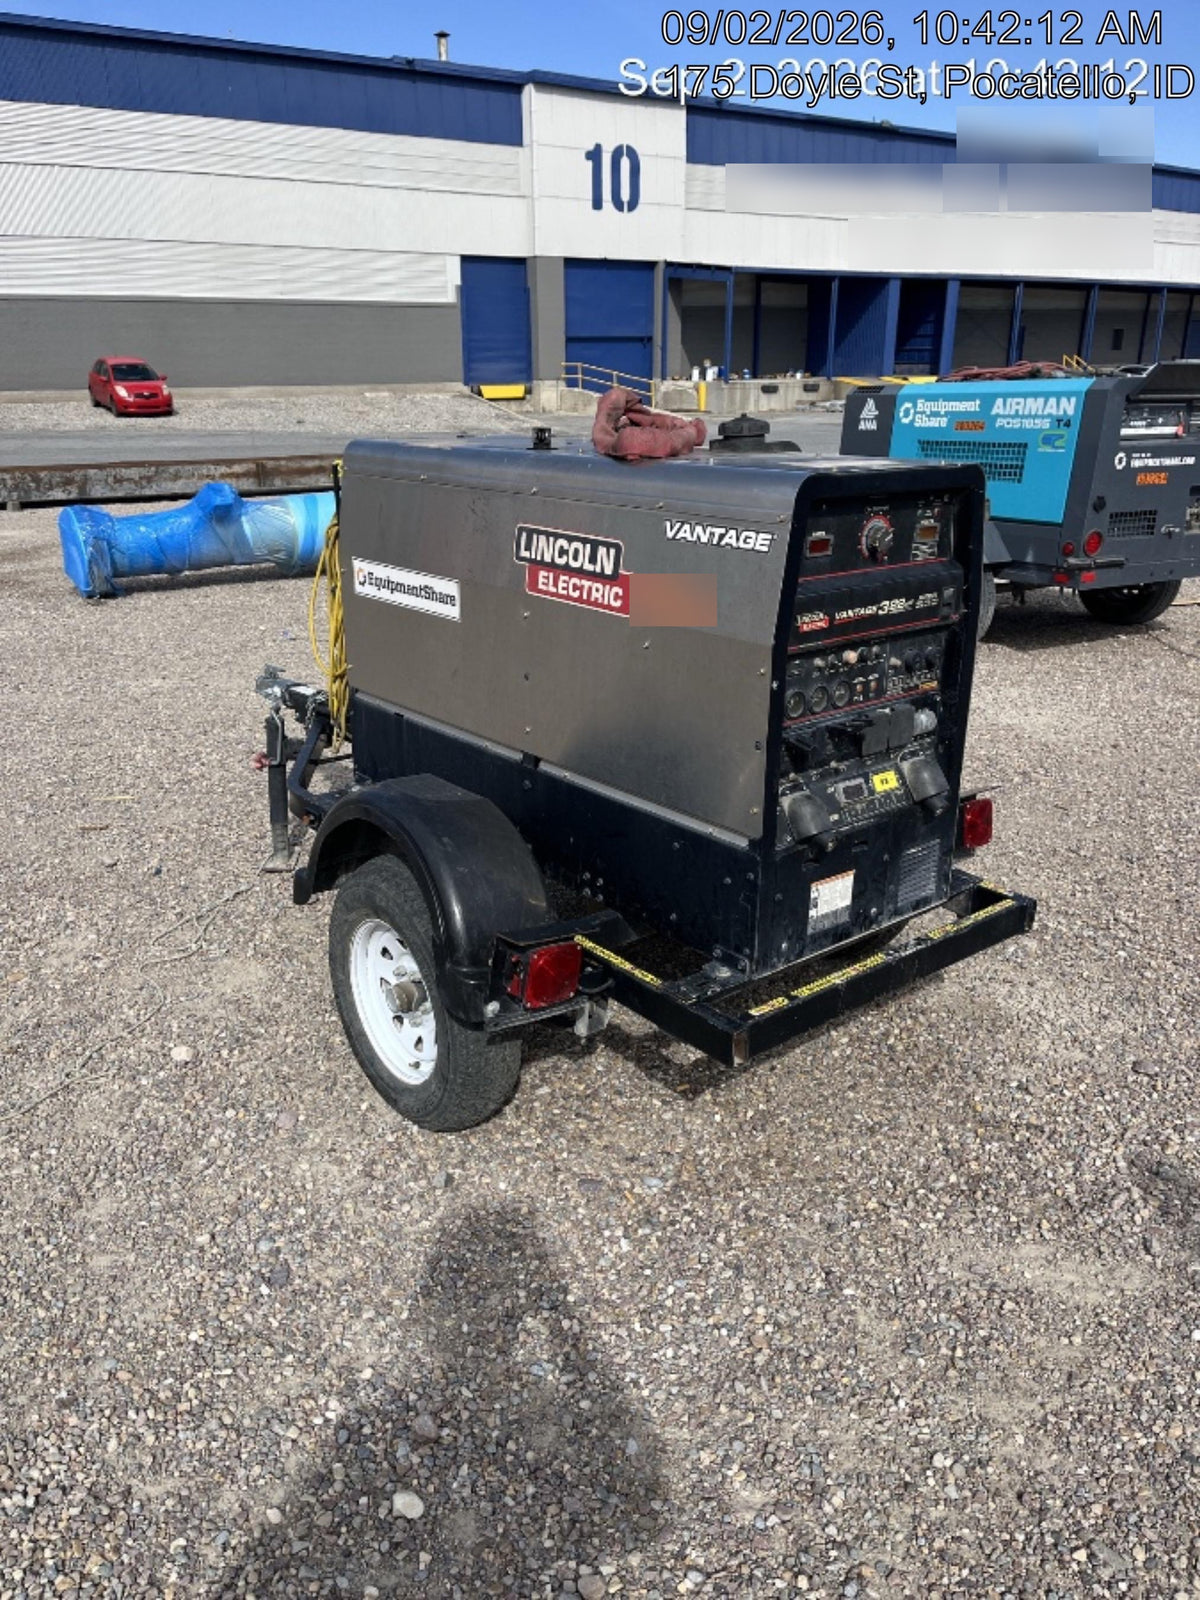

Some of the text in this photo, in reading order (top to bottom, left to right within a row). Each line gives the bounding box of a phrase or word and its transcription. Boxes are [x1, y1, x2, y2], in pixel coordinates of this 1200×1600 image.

[584, 142, 641, 213] 10
[914, 414, 948, 428] Share
[916, 399, 980, 415] Equipment
[990, 396, 1077, 416] AIRMAN
[664, 519, 773, 553] VANTAGE
[519, 531, 617, 577] LINCOLN
[367, 571, 456, 607] EquipmentShare
[537, 570, 624, 608] ELECTRIC
